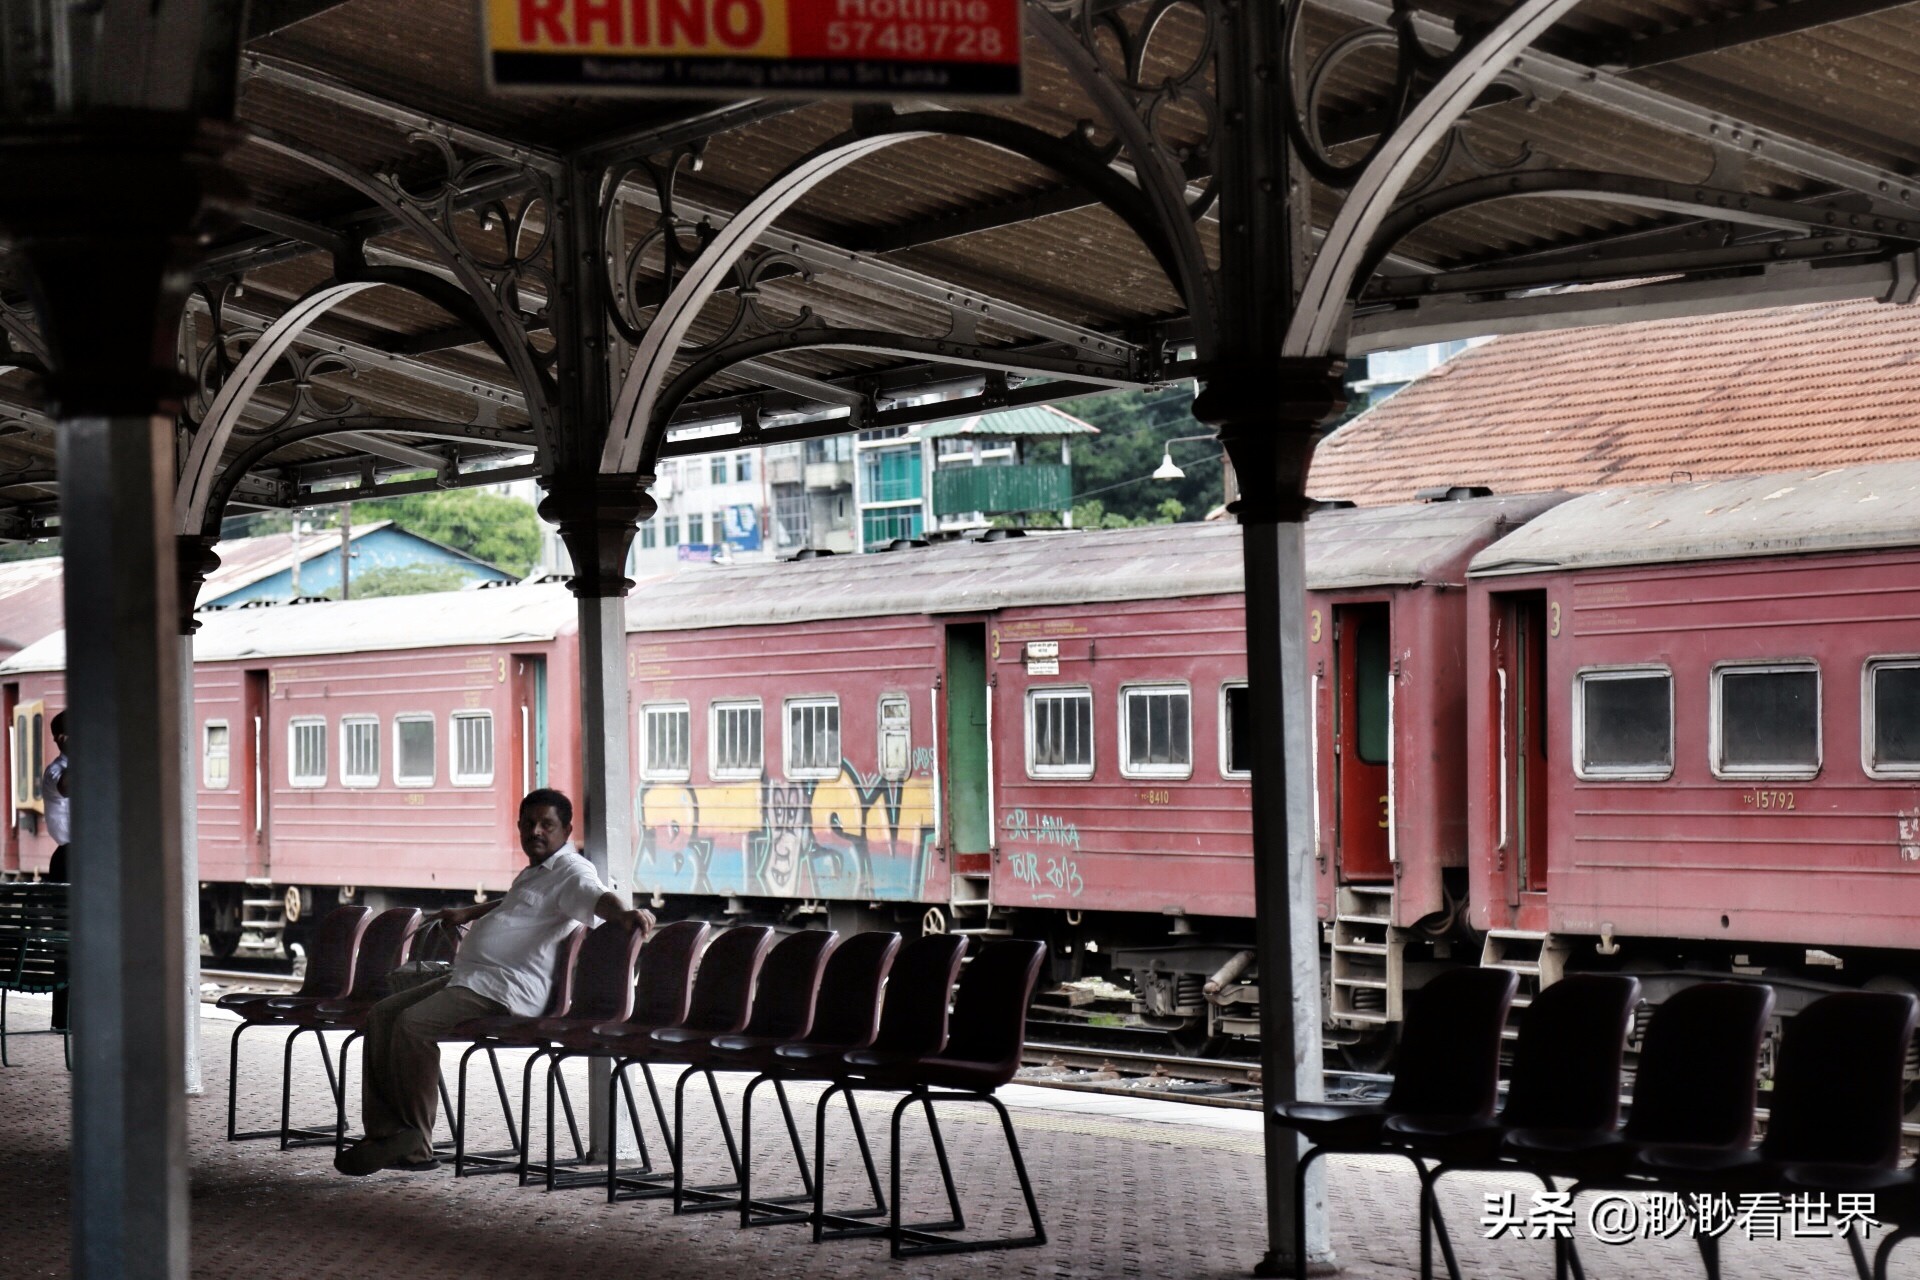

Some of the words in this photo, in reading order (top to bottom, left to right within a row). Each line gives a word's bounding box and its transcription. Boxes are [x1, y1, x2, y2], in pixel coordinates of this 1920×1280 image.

[519, 0, 765, 48] RHINO
[837, 0, 989, 21] Hotline
[827, 21, 1002, 56] 5748728
[582, 58, 666, 79] Number
[888, 63, 950, 85] Lanka
[1310, 609, 1322, 643] 3
[1551, 601, 1560, 637] 3
[991, 629, 1000, 659] 3
[498, 657, 506, 683] 3
[1006, 809, 1080, 850] SRI-LANKA
[1008, 854, 1041, 889] TOUR
[1046, 856, 1084, 897] 2013
